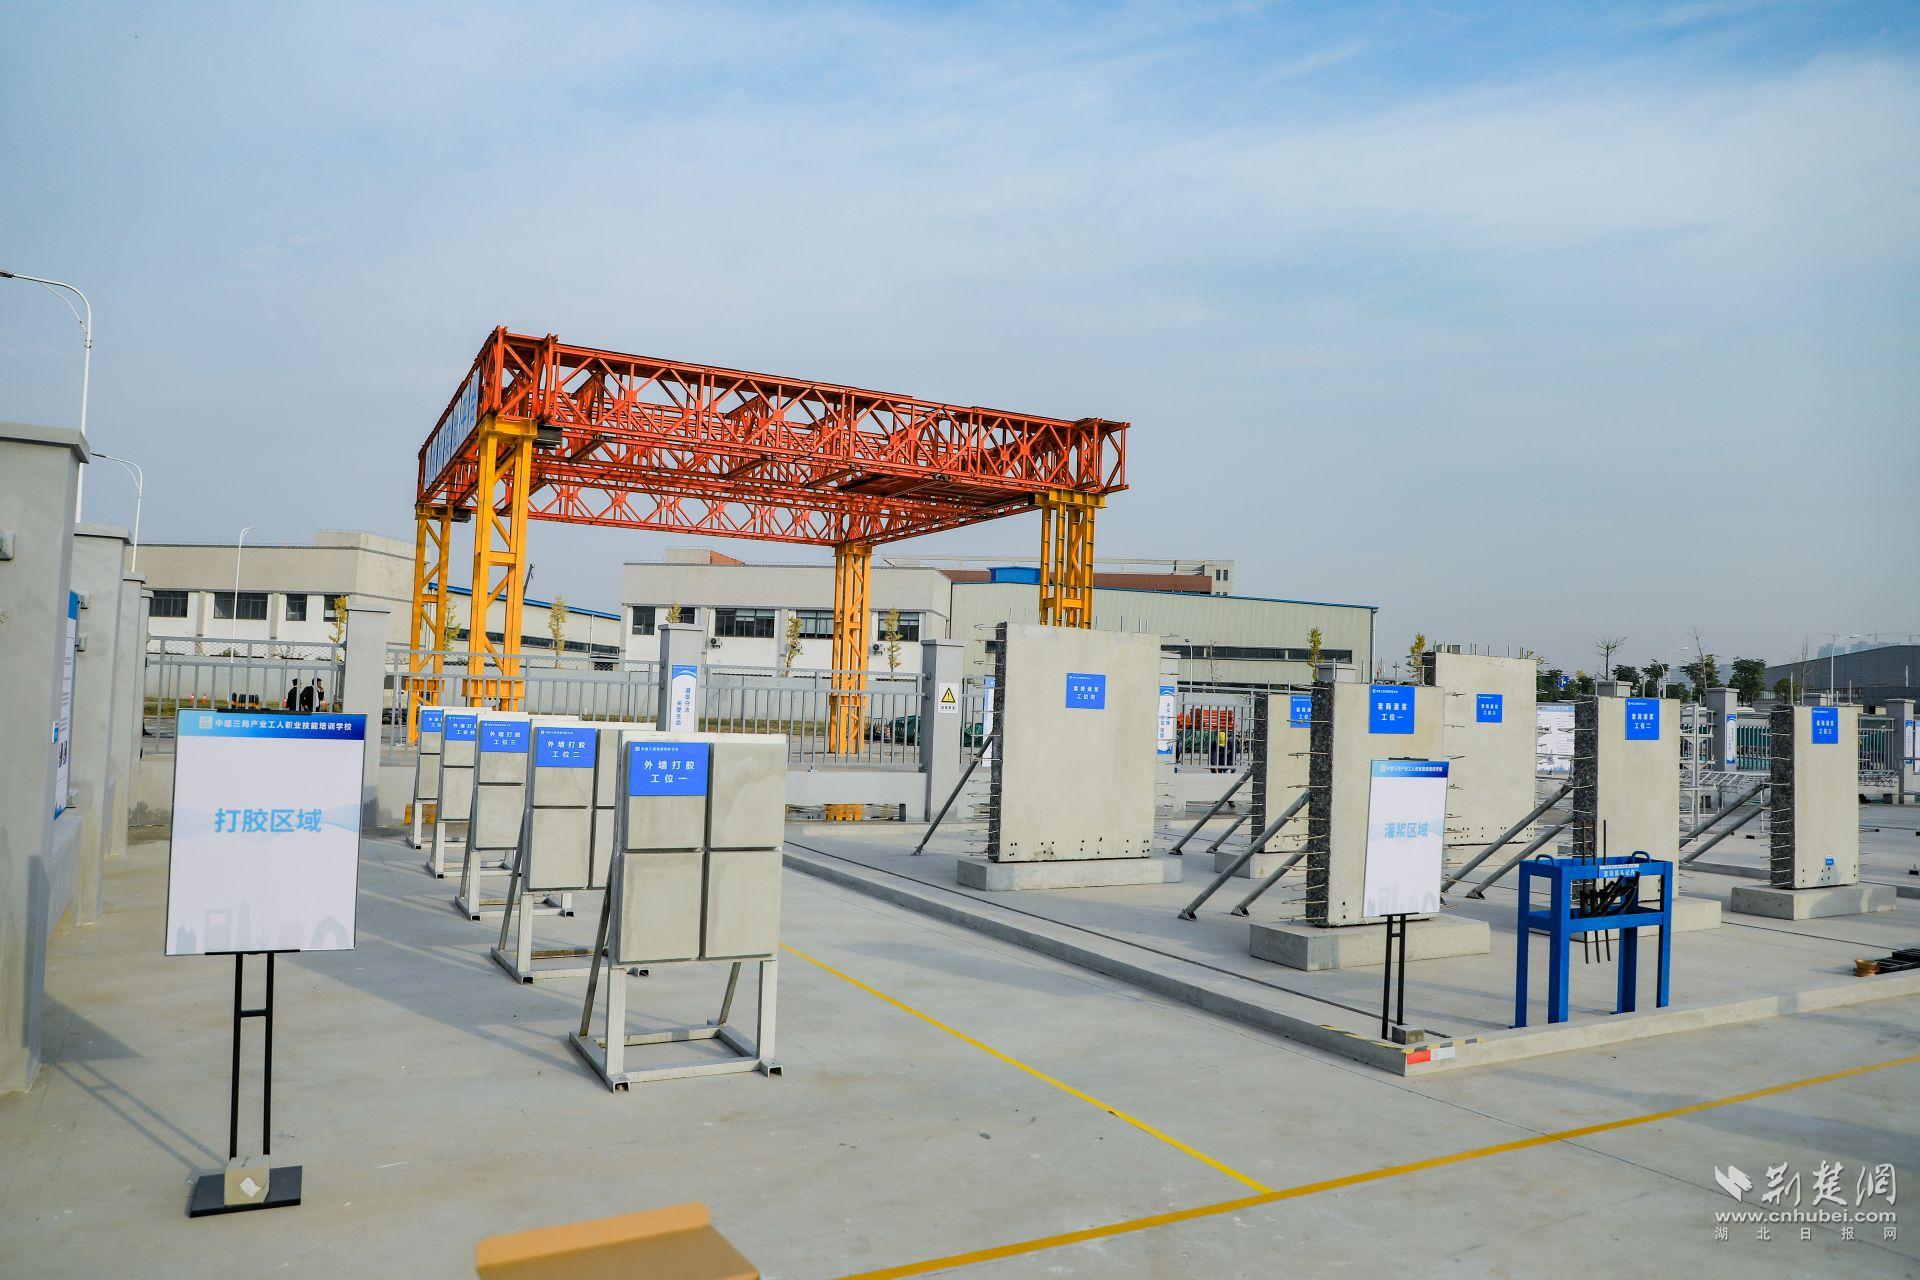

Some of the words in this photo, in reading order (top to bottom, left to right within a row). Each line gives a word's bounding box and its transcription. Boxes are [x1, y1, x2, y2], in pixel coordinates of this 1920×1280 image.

[1381, 713, 1404, 721] 工位一
[215, 719, 352, 731] 中建三局产业工人职业技能培训学校
[493, 739, 518, 747] 工位三
[547, 740, 586, 749] 外墙打胶
[551, 751, 580, 759] 工位二
[644, 760, 696, 770] 外墙打胶
[650, 773, 688, 783] 工位一
[214, 808, 322, 833] 打胶区域
[1384, 821, 1429, 839] 灌浆区域
